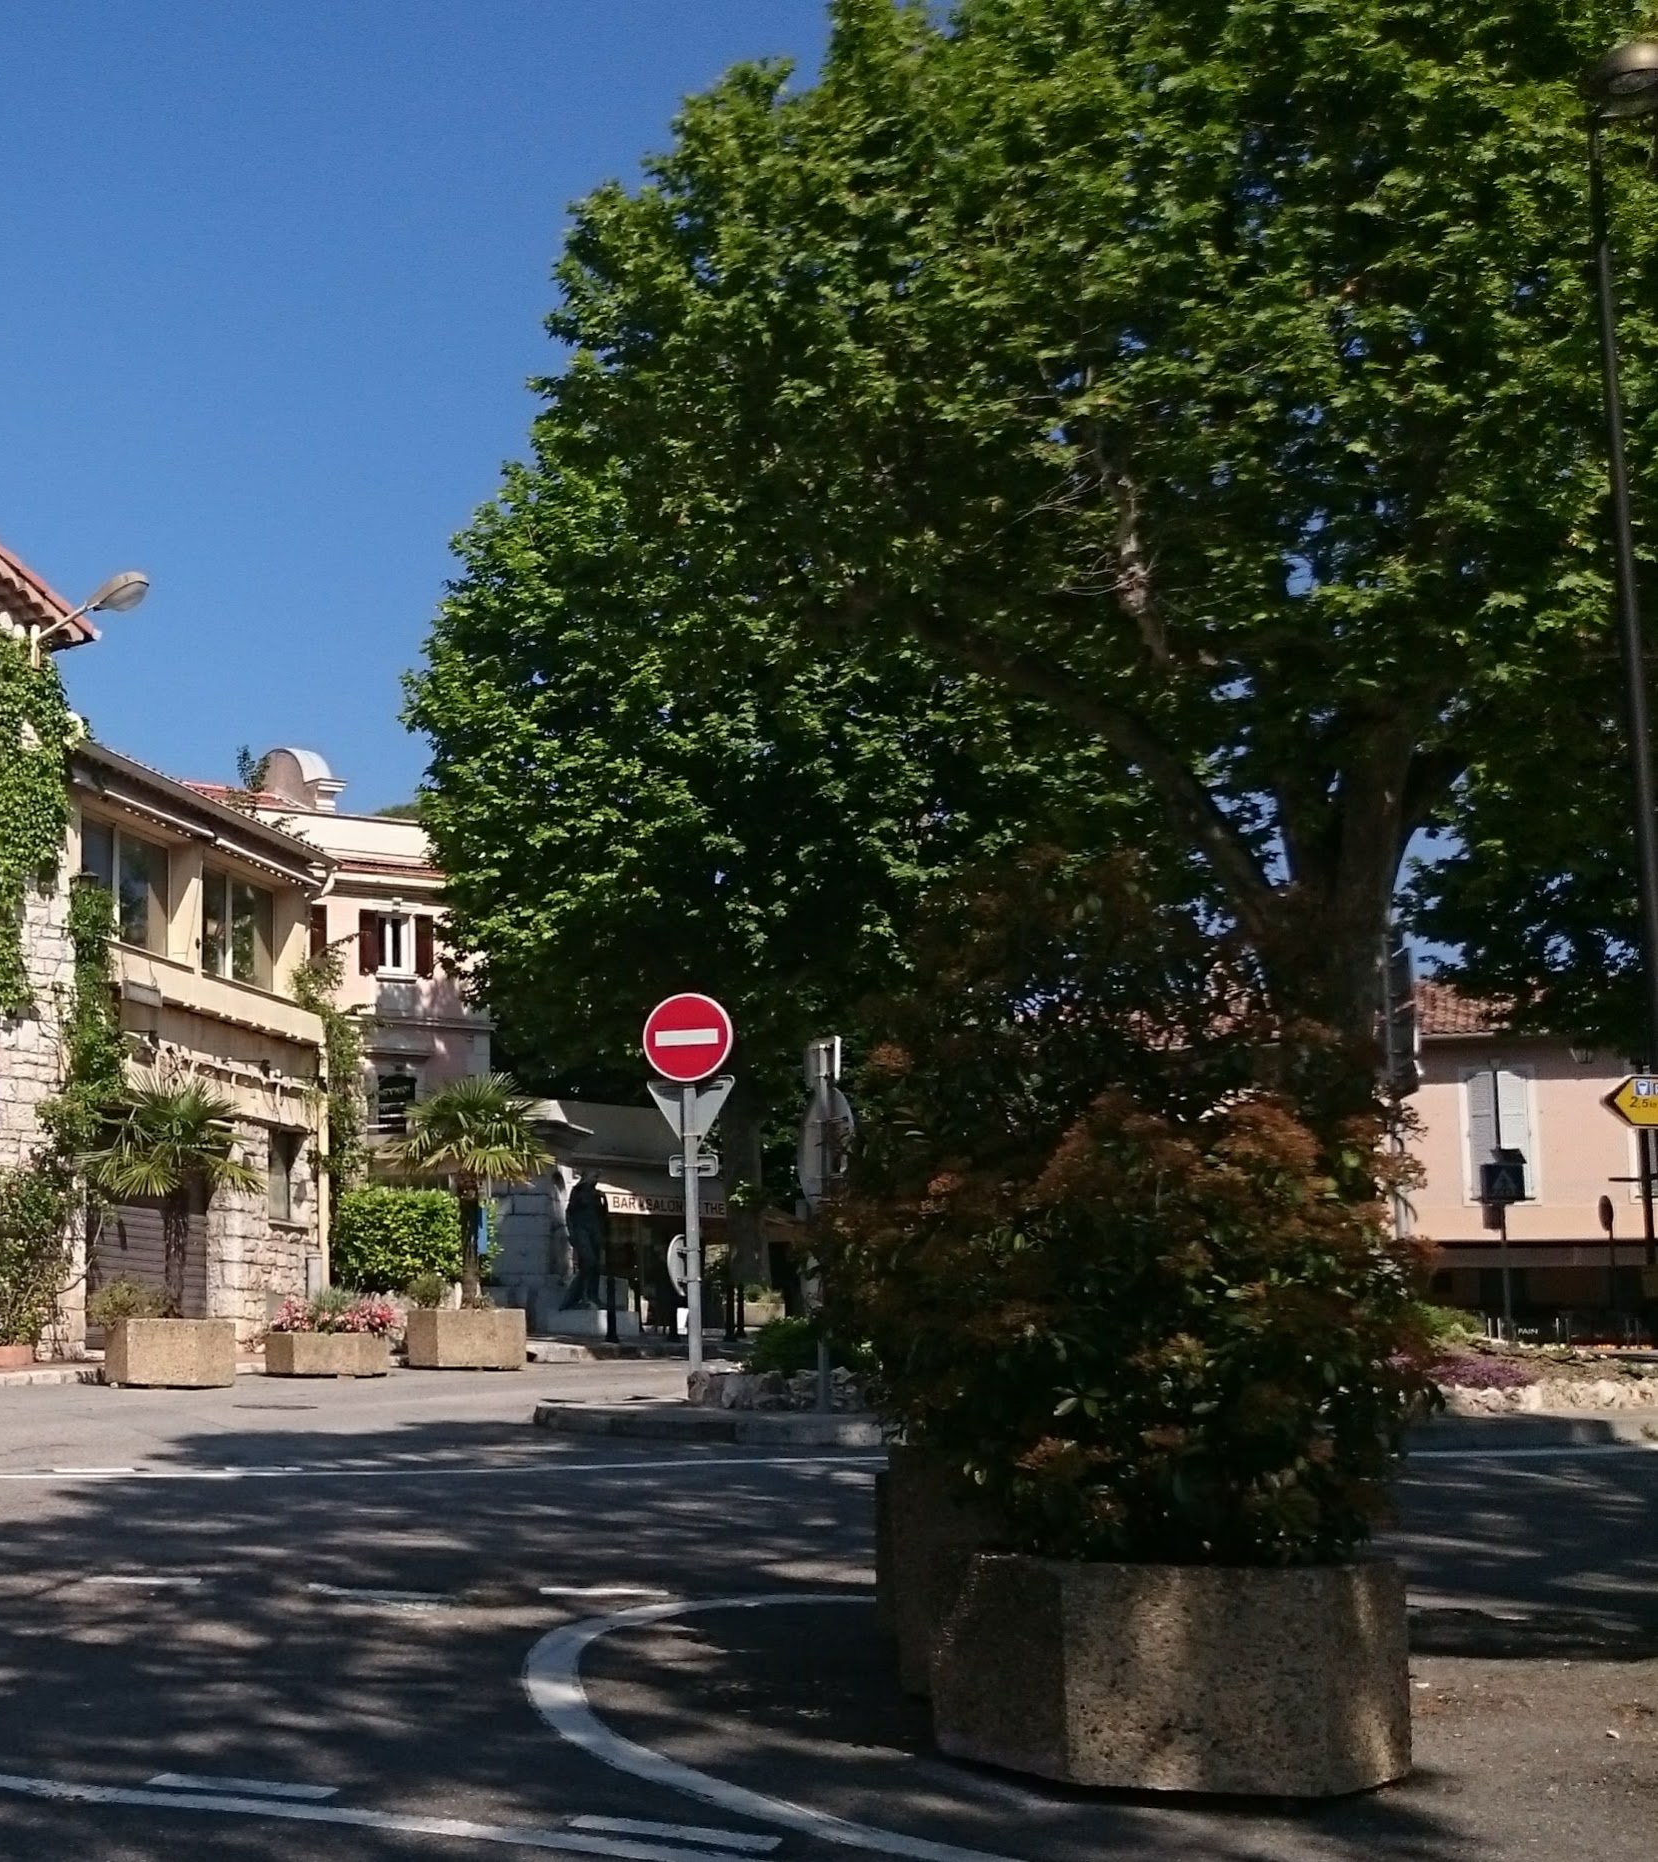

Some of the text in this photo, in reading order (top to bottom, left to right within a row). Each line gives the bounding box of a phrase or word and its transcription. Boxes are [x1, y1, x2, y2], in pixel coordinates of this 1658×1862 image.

[612, 1196, 636, 1210] BAR
[646, 1198, 683, 1212] SALON
[703, 1202, 725, 1215] THE
